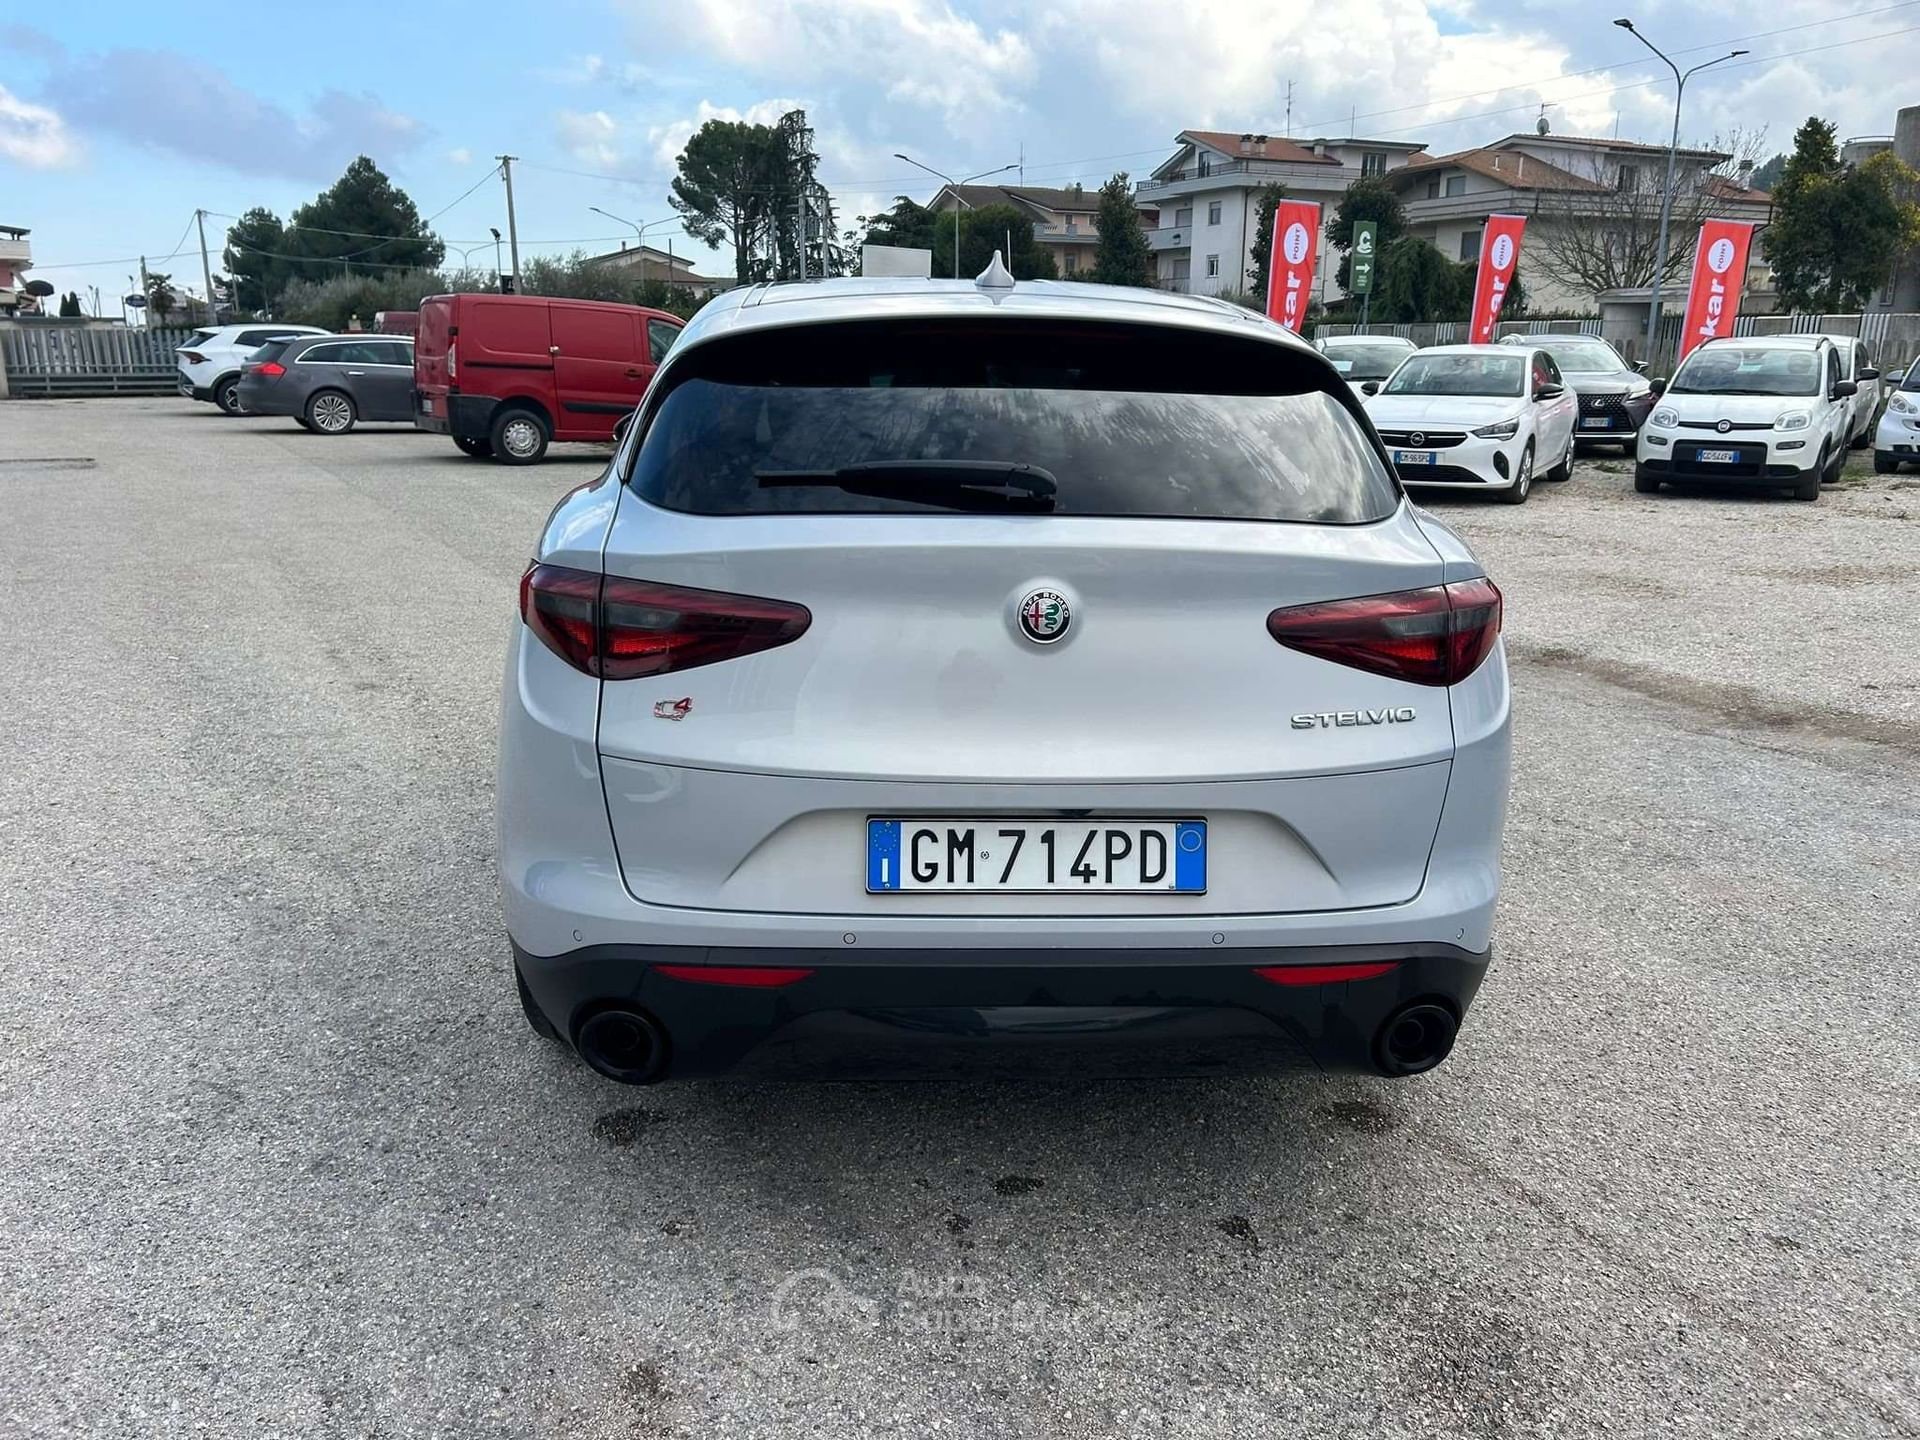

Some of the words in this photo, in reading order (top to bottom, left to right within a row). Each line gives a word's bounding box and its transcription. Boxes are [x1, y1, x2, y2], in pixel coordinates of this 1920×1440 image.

[1292, 228, 1301, 260] POINT
[1717, 242, 1727, 270] POINT
[1023, 595, 1040, 616] ALFA
[1043, 592, 1069, 617] ROMEO
[1291, 706, 1417, 729] STELVIO
[910, 829, 975, 883] GM
[998, 829, 1167, 884] 714PD
